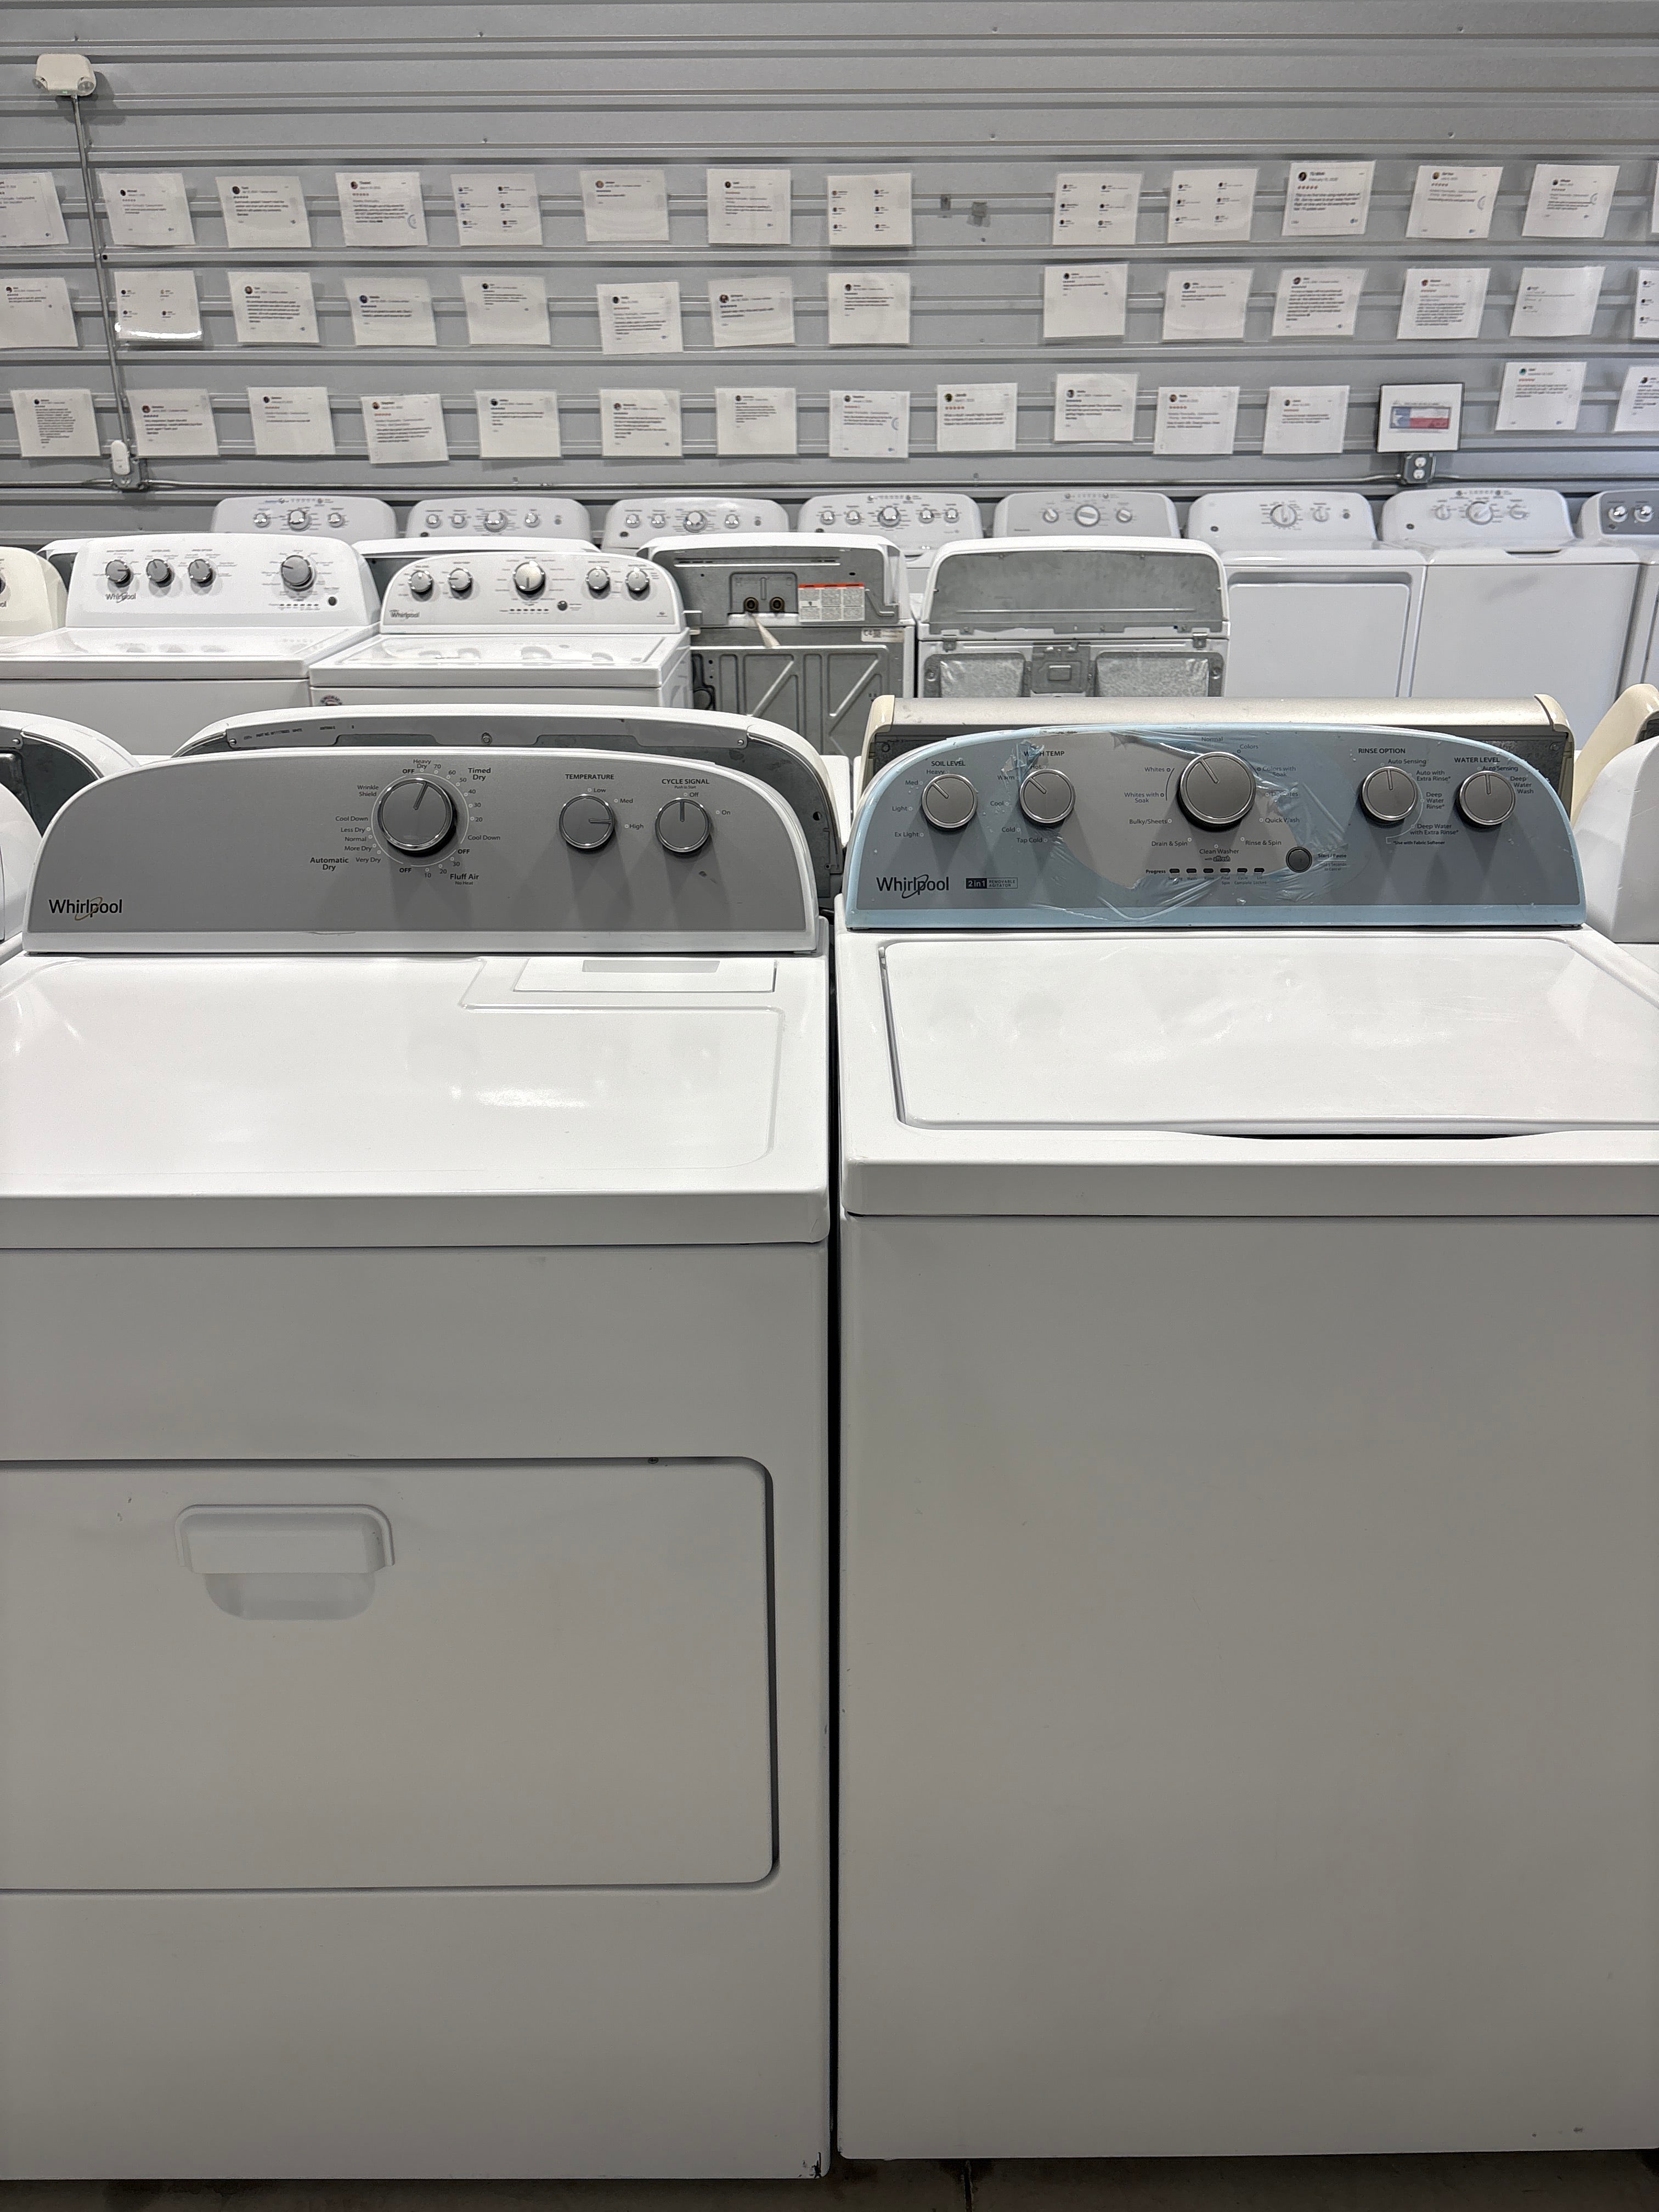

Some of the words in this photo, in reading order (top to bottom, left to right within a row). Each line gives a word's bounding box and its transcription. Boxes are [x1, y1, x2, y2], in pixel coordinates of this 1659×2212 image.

[105, 592, 136, 603] Whirlpool
[1174, 840, 1188, 849] Spin
[876, 875, 949, 896] Whirlpool
[48, 899, 122, 918] Whirlpool
